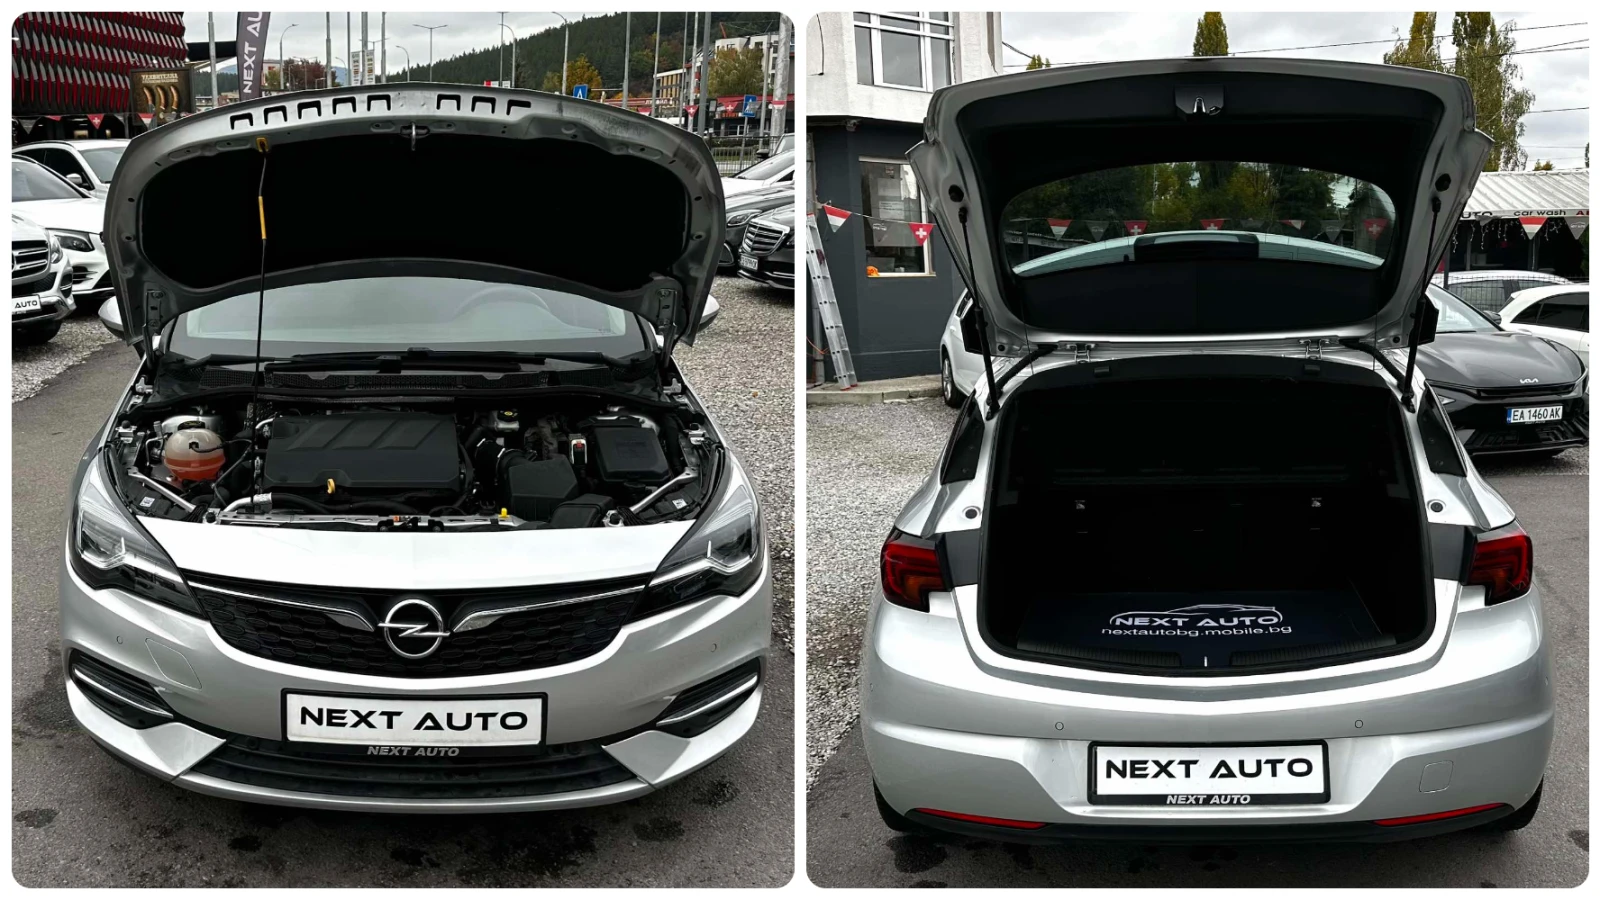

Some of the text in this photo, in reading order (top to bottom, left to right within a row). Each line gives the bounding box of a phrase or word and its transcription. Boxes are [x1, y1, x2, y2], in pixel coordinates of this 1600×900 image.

[243, 41, 257, 93] NEXT
[14, 300, 38, 309] AUTO
[1512, 407, 1561, 421] EA 1460 AK
[1115, 616, 1279, 626] NEXT AUTO
[1101, 626, 1292, 637] nextautobg.mobile.bg
[300, 706, 528, 731] NEXT AUTO
[367, 746, 460, 757] NEXT AUTO
[1106, 758, 1313, 779] NEXT AUTO
[1166, 794, 1251, 805] NEXT AUTO
